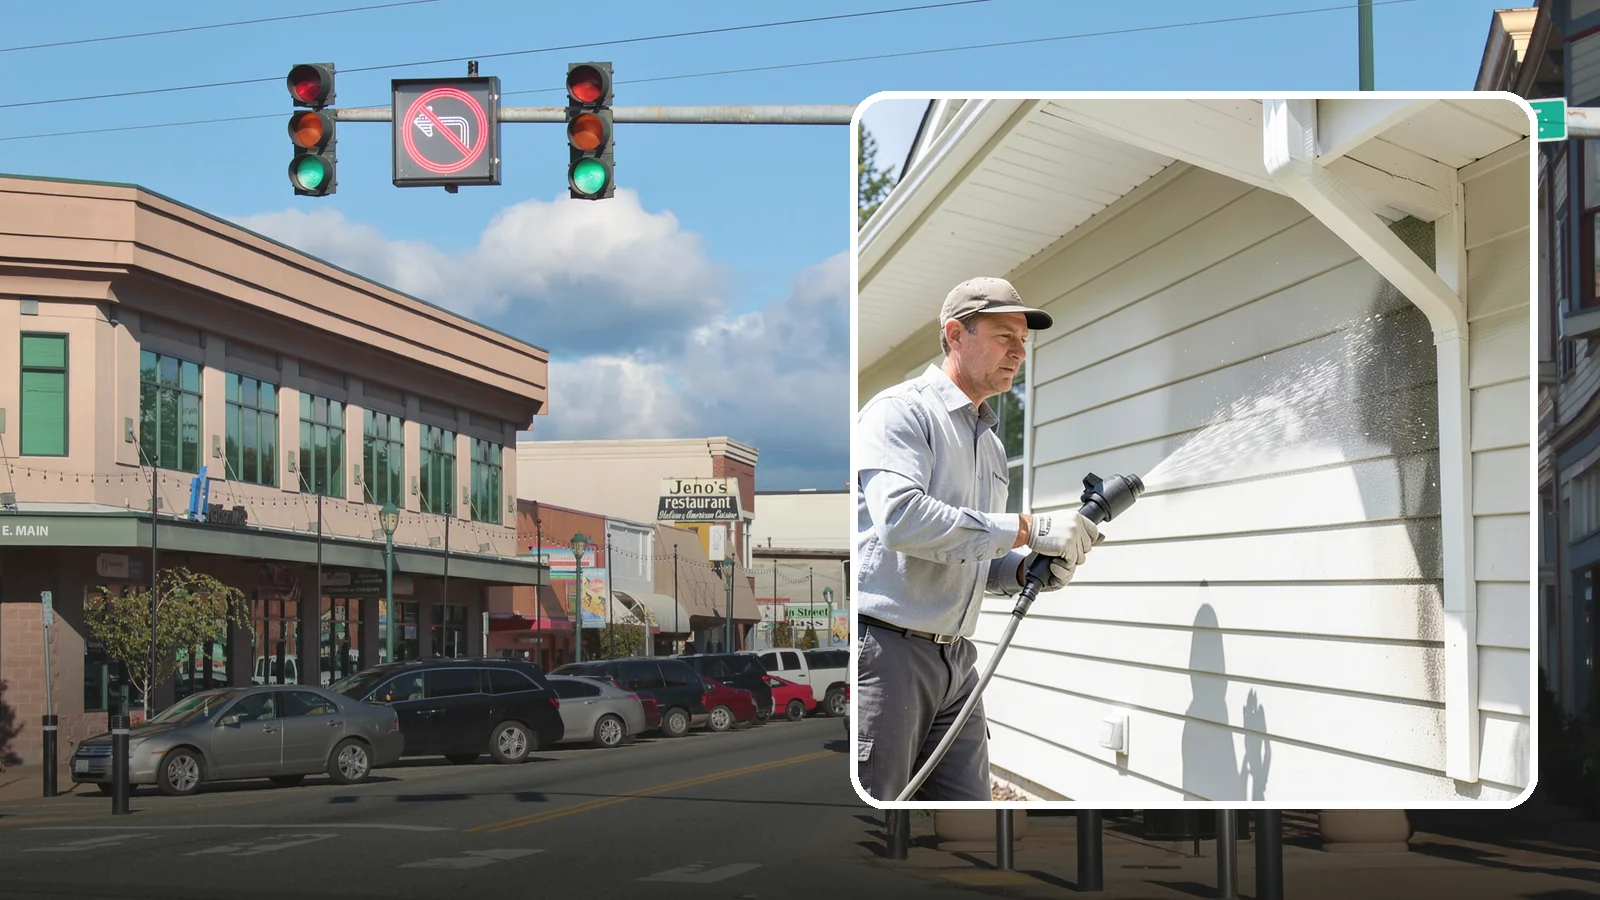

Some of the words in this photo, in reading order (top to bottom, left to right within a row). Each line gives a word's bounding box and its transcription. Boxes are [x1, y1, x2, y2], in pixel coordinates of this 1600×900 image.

[670, 480, 727, 494] Jeno's
[665, 496, 731, 509] restaurant
[658, 510, 680, 519] Italian
[685, 510, 714, 519] American
[715, 510, 738, 519] Cuisine
[2, 525, 13, 536] E.
[15, 525, 49, 536] MAIN
[785, 606, 795, 617] in
[797, 607, 828, 617] Street
